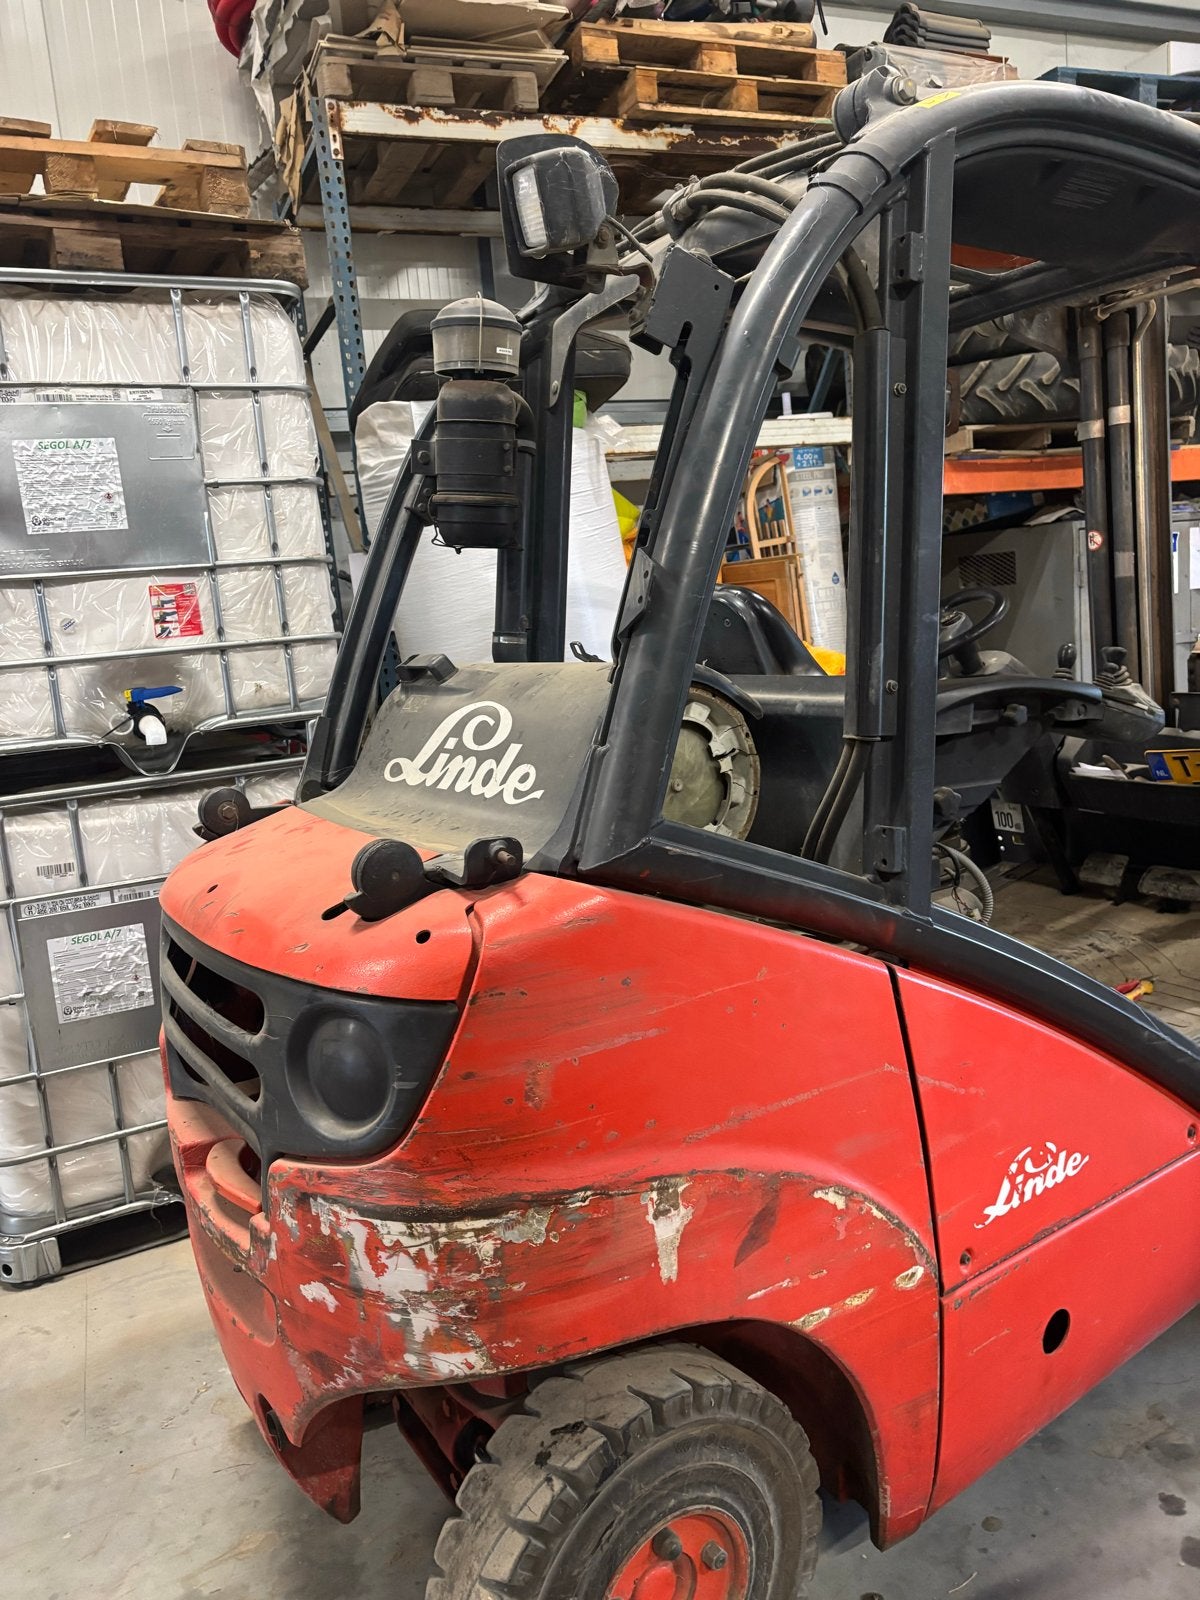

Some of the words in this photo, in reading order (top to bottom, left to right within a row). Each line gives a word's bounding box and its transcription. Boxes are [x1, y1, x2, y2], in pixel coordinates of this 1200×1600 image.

[37, 441, 72, 450] SEGOL
[72, 440, 91, 450] A/7
[384, 700, 545, 805] Linde
[995, 811, 1014, 829] 100
[71, 933, 102, 945] SEGOL
[104, 929, 122, 940] A/7
[973, 1141, 1090, 1229] Linde
